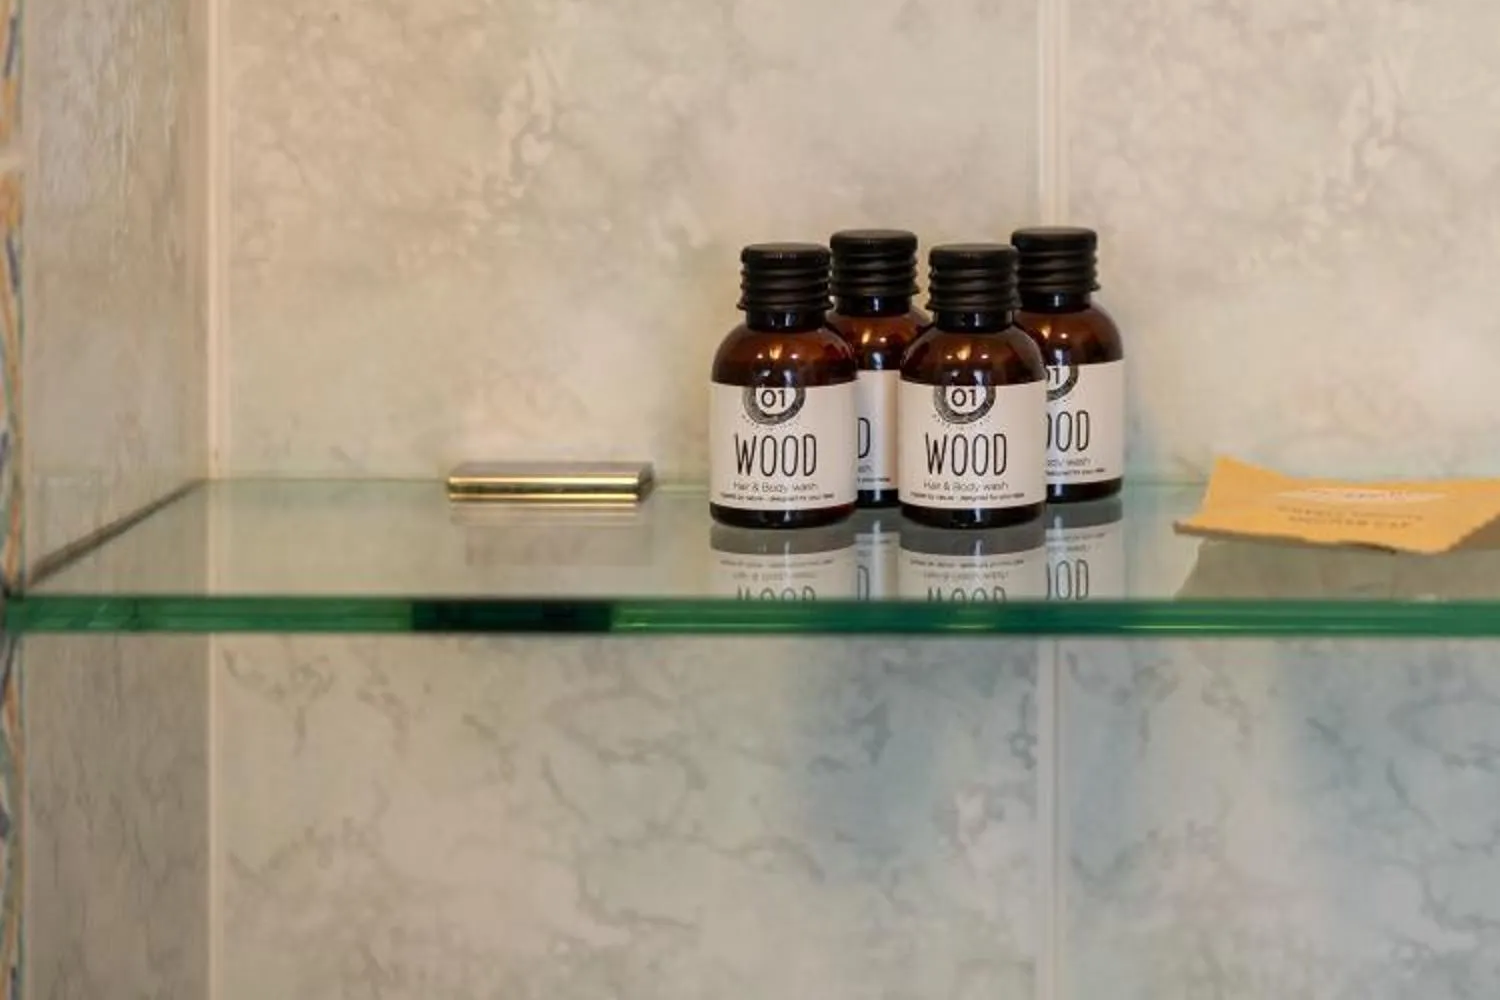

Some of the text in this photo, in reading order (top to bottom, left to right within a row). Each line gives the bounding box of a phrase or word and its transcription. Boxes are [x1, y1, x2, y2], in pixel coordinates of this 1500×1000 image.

[734, 433, 817, 477] WOOD
[925, 432, 1007, 476] WOOD
[733, 482, 750, 491] Hair
[762, 482, 788, 494] Body
[923, 482, 941, 491] Hair
[943, 481, 951, 492] &
[952, 482, 980, 493] Body
